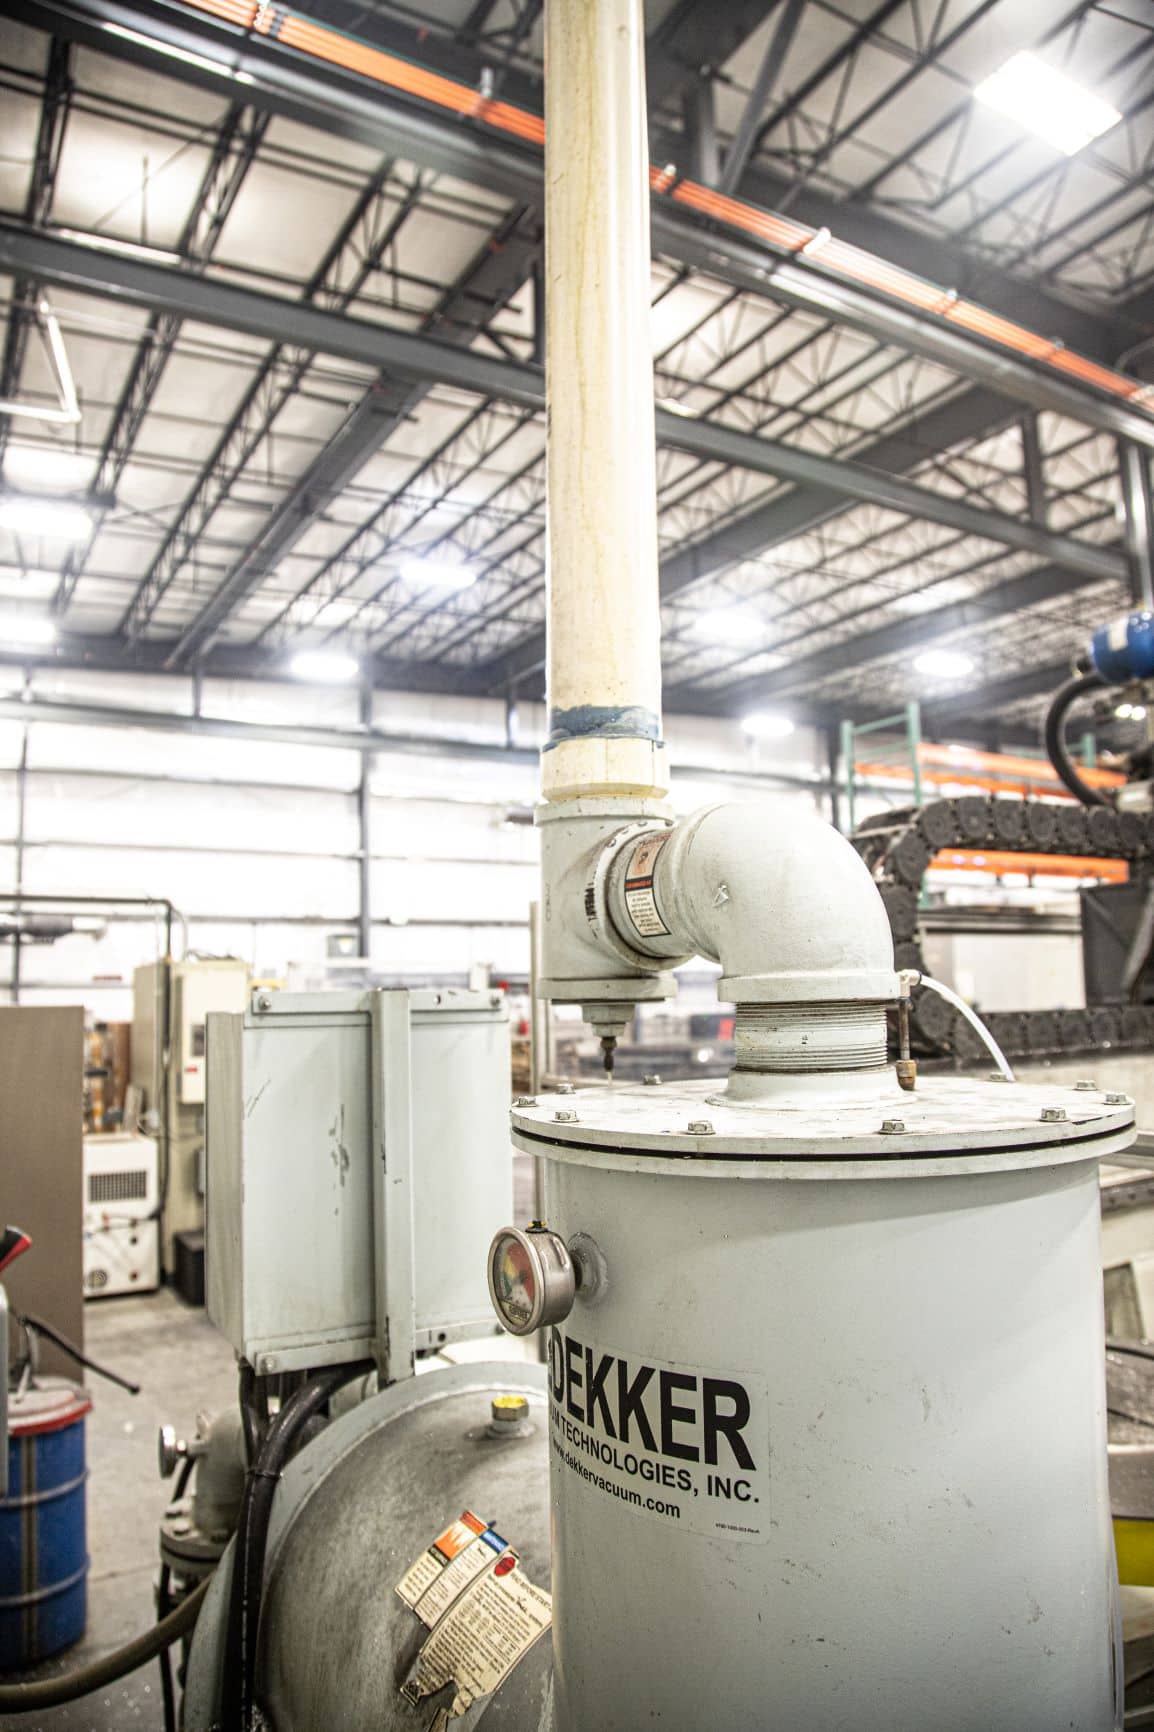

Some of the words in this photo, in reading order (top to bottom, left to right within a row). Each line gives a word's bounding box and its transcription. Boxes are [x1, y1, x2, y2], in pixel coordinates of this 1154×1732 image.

[551, 1325, 757, 1471] DEKKER
[561, 1416, 699, 1497] TECHNOLOGIES,
[707, 1475, 760, 1504] INC.
